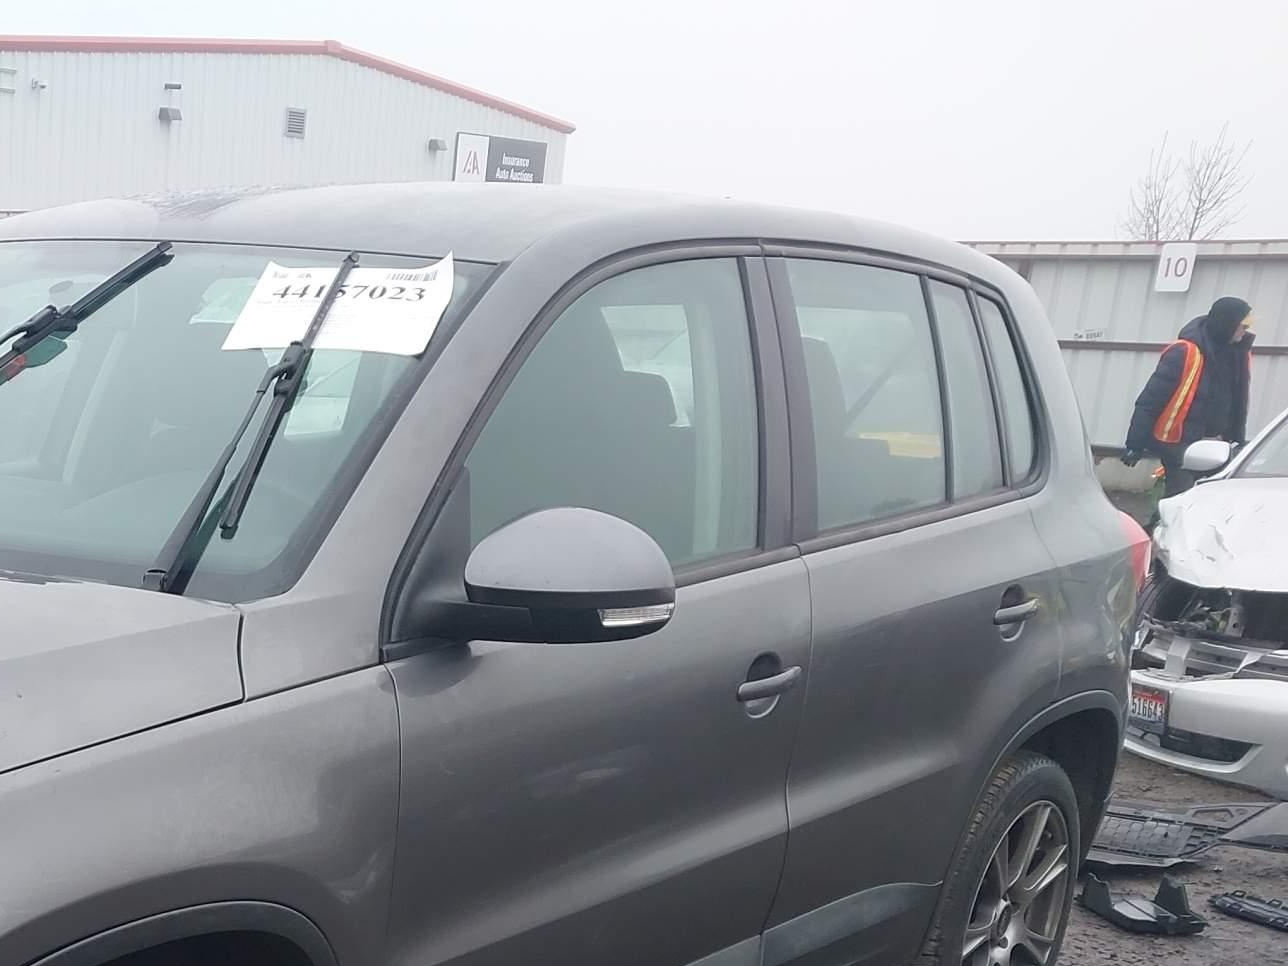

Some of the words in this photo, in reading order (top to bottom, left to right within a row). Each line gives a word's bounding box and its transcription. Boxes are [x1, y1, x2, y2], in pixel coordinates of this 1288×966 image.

[502, 153, 530, 167] Insurance
[495, 166, 509, 179] Auto
[509, 168, 533, 182] Auctions
[1164, 257, 1189, 278] 10
